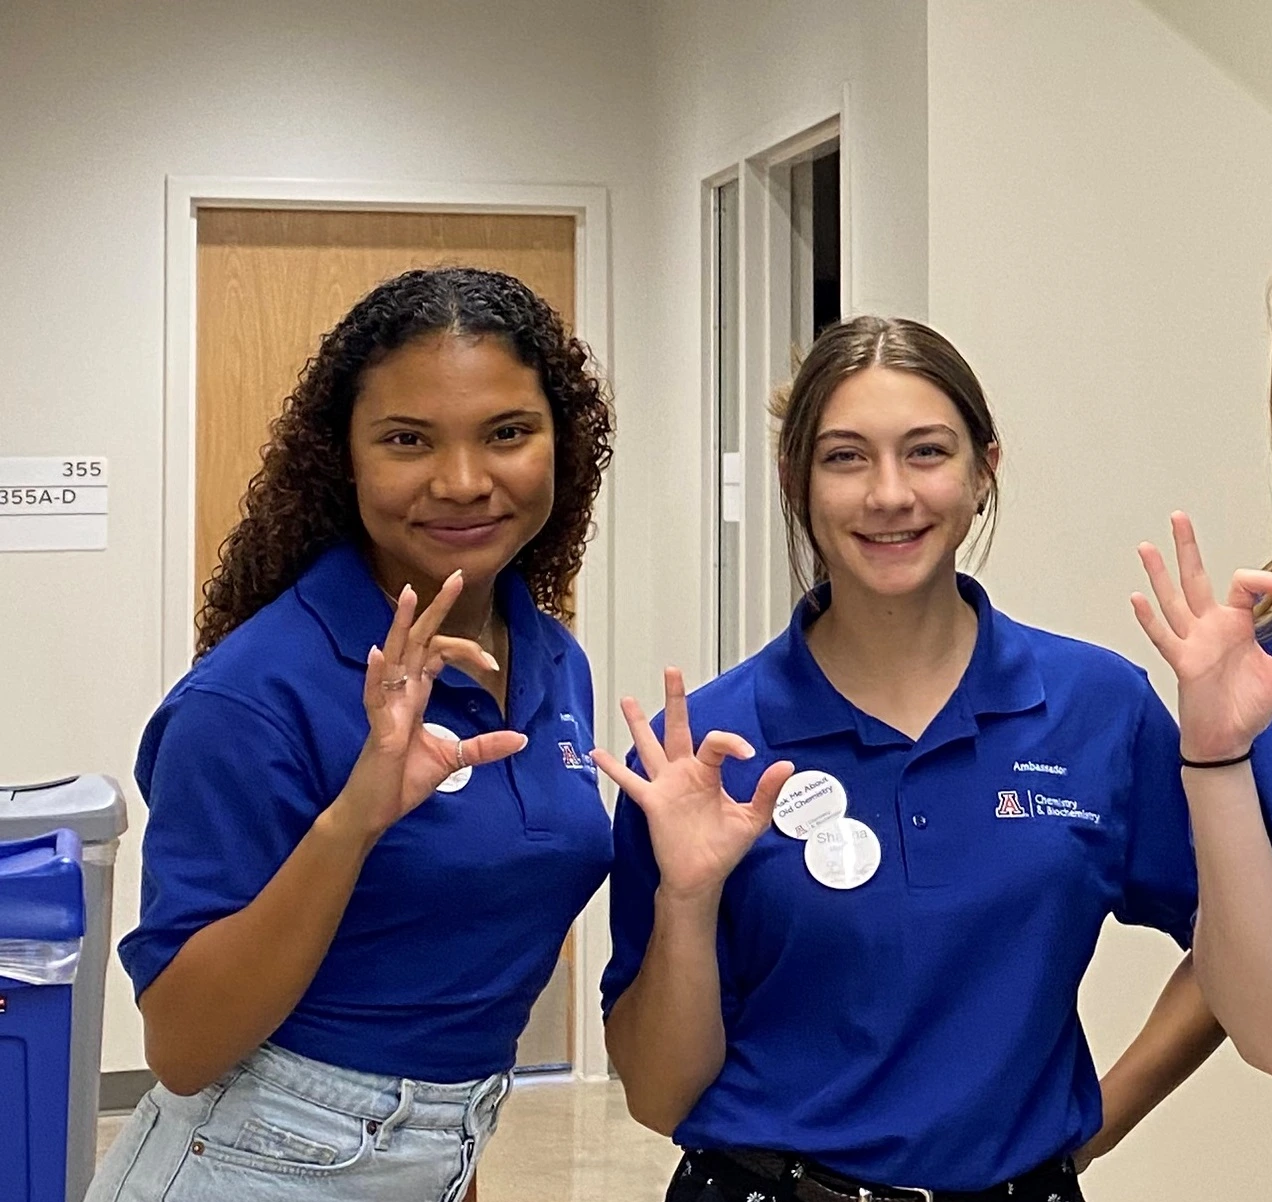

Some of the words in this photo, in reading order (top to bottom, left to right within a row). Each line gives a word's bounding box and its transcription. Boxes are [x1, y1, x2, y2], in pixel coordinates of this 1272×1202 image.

[62, 461, 102, 477] 355
[0, 488, 77, 505] 355A-D
[1013, 761, 1068, 776] Ambassador
[789, 791, 803, 800] Me
[804, 776, 829, 793] About
[794, 785, 834, 809] Chemistry
[995, 791, 1026, 818] A
[1034, 794, 1078, 810] Chemistry
[1046, 806, 1100, 824] Biochemistry
